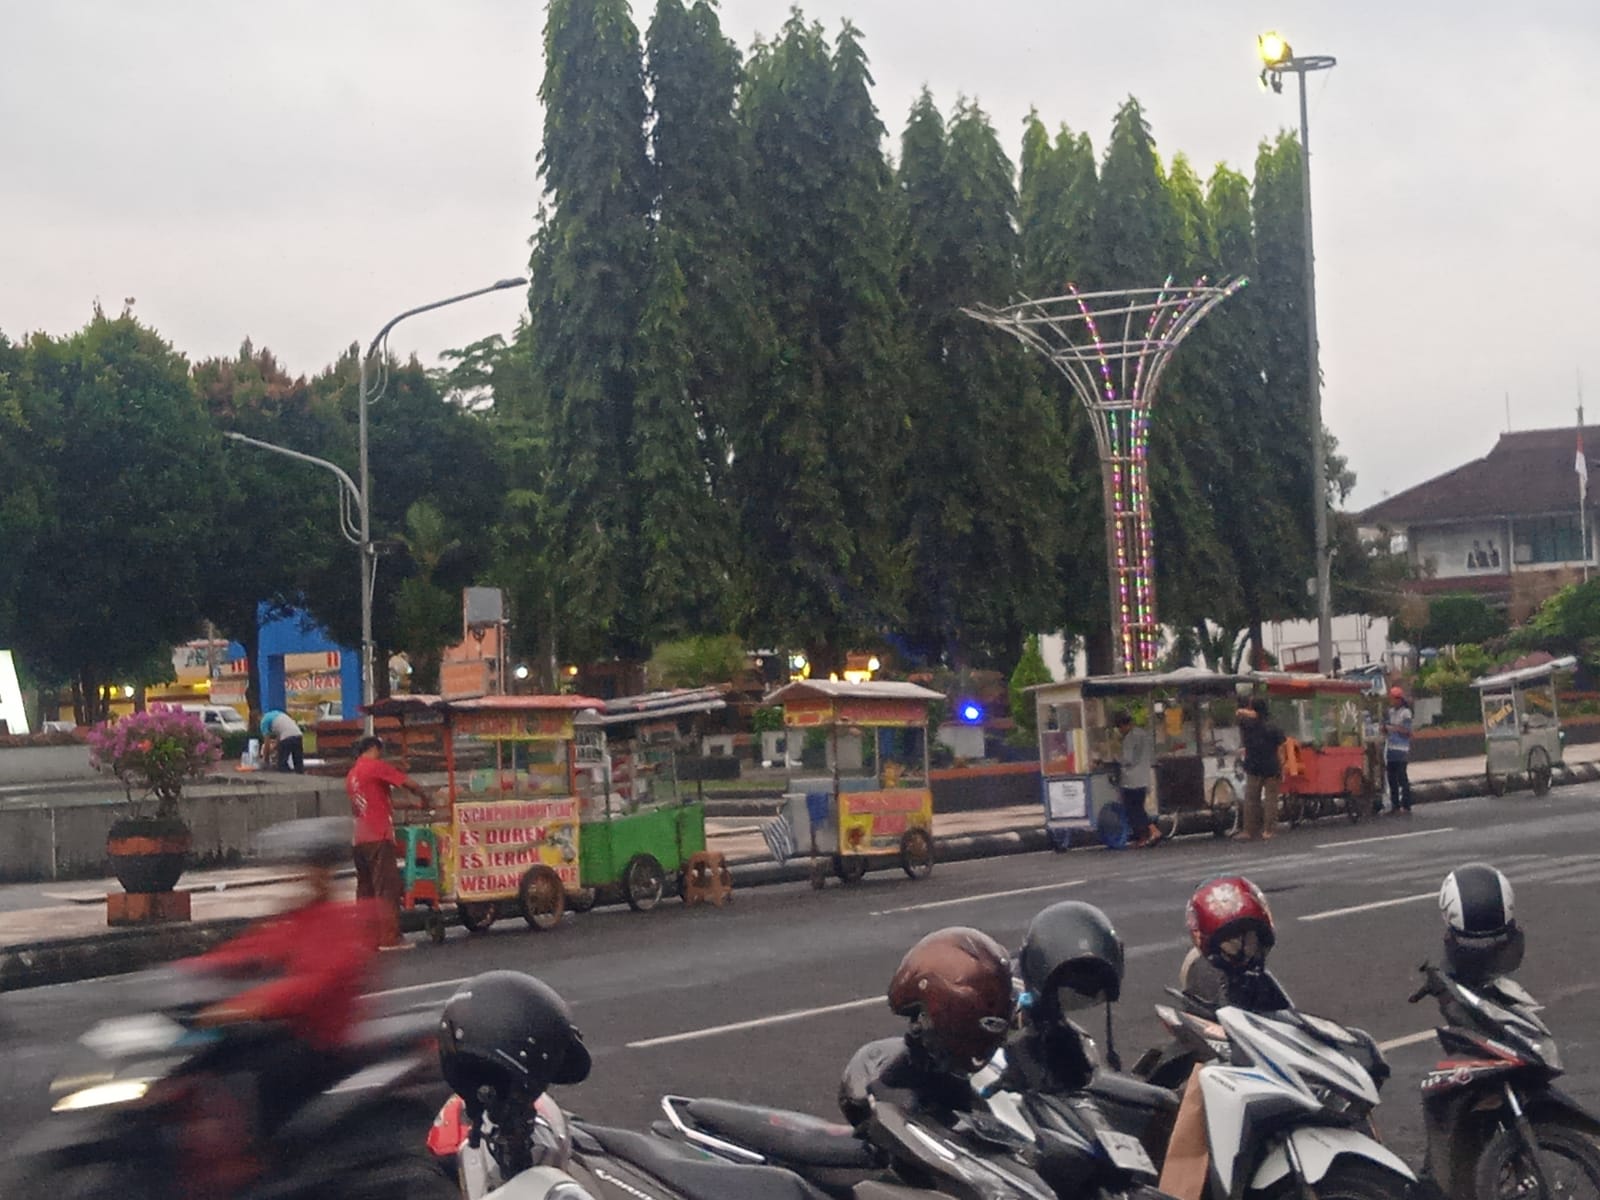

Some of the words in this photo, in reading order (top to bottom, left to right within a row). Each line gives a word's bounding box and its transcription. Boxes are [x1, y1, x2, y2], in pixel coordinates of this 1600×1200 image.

[459, 830, 480, 846] ES
[486, 826, 546, 845] DUREN
[461, 852, 483, 869] ES
